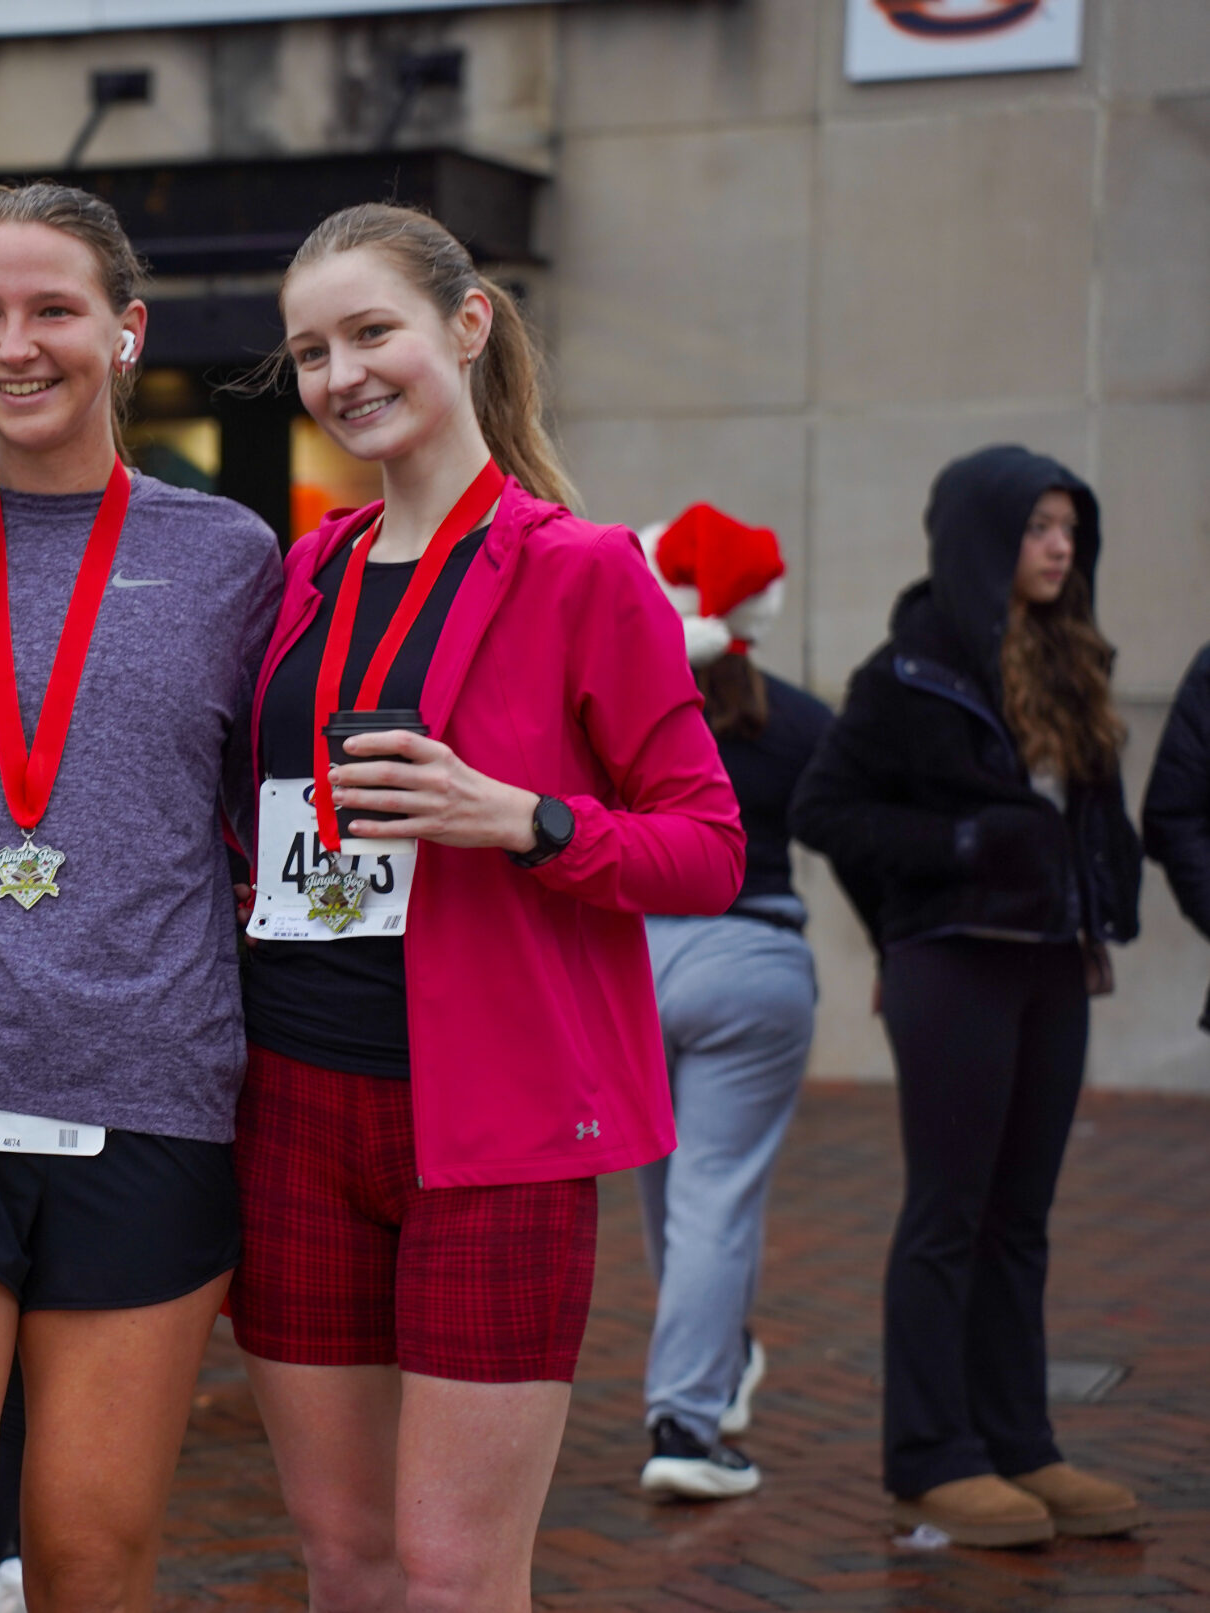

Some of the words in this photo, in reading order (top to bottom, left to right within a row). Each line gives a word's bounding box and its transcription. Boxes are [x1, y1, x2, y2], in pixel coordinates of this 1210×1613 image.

[37, 849, 61, 869] Jog
[303, 873, 341, 895] Jingle
[342, 873, 367, 891] Jog
